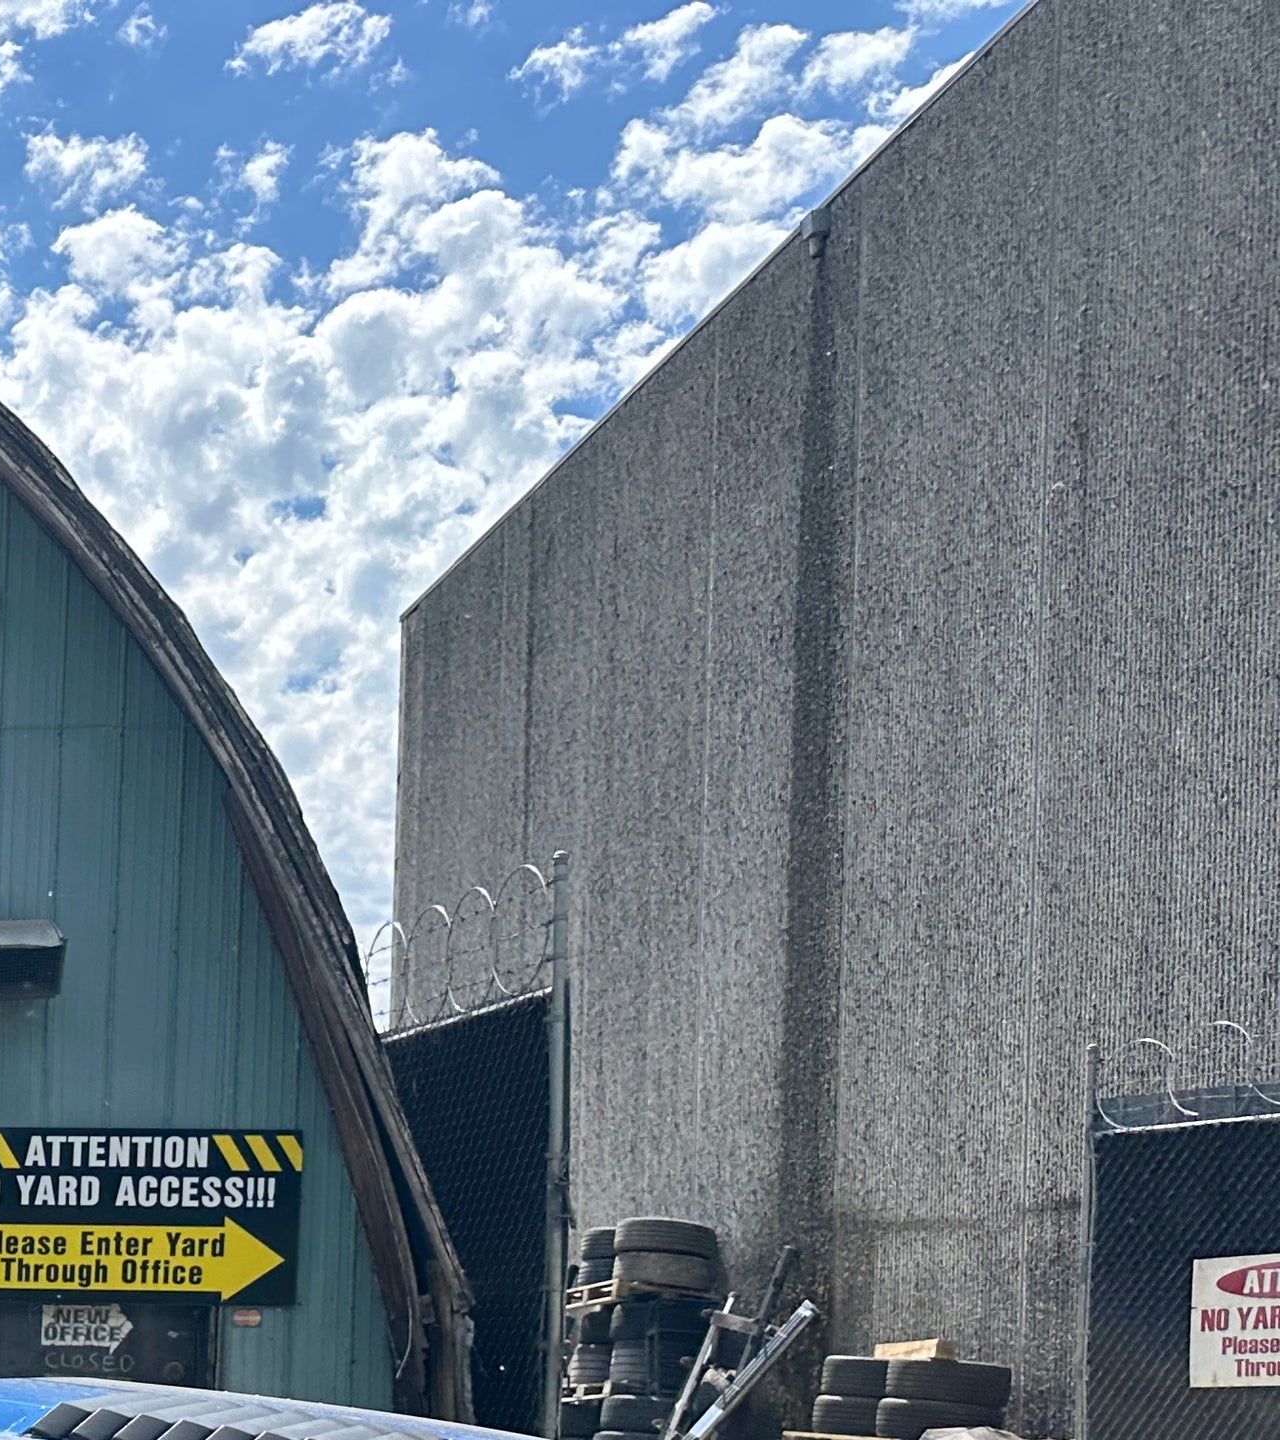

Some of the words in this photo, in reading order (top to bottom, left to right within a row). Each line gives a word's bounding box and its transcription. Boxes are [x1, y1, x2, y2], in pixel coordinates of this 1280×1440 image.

[24, 1135, 209, 1168] ATTENTION
[16, 1175, 100, 1207] YARD
[115, 1176, 276, 1208] ACCESS!!!
[80, 1231, 153, 1257] Enter
[166, 1232, 226, 1257] Yard
[0, 1258, 108, 1288] Through
[121, 1260, 203, 1285] Office
[53, 1308, 111, 1325] NEW
[1200, 1308, 1229, 1332] NO
[44, 1325, 123, 1343] OFFICE
[45, 1351, 135, 1373] CLOSED
